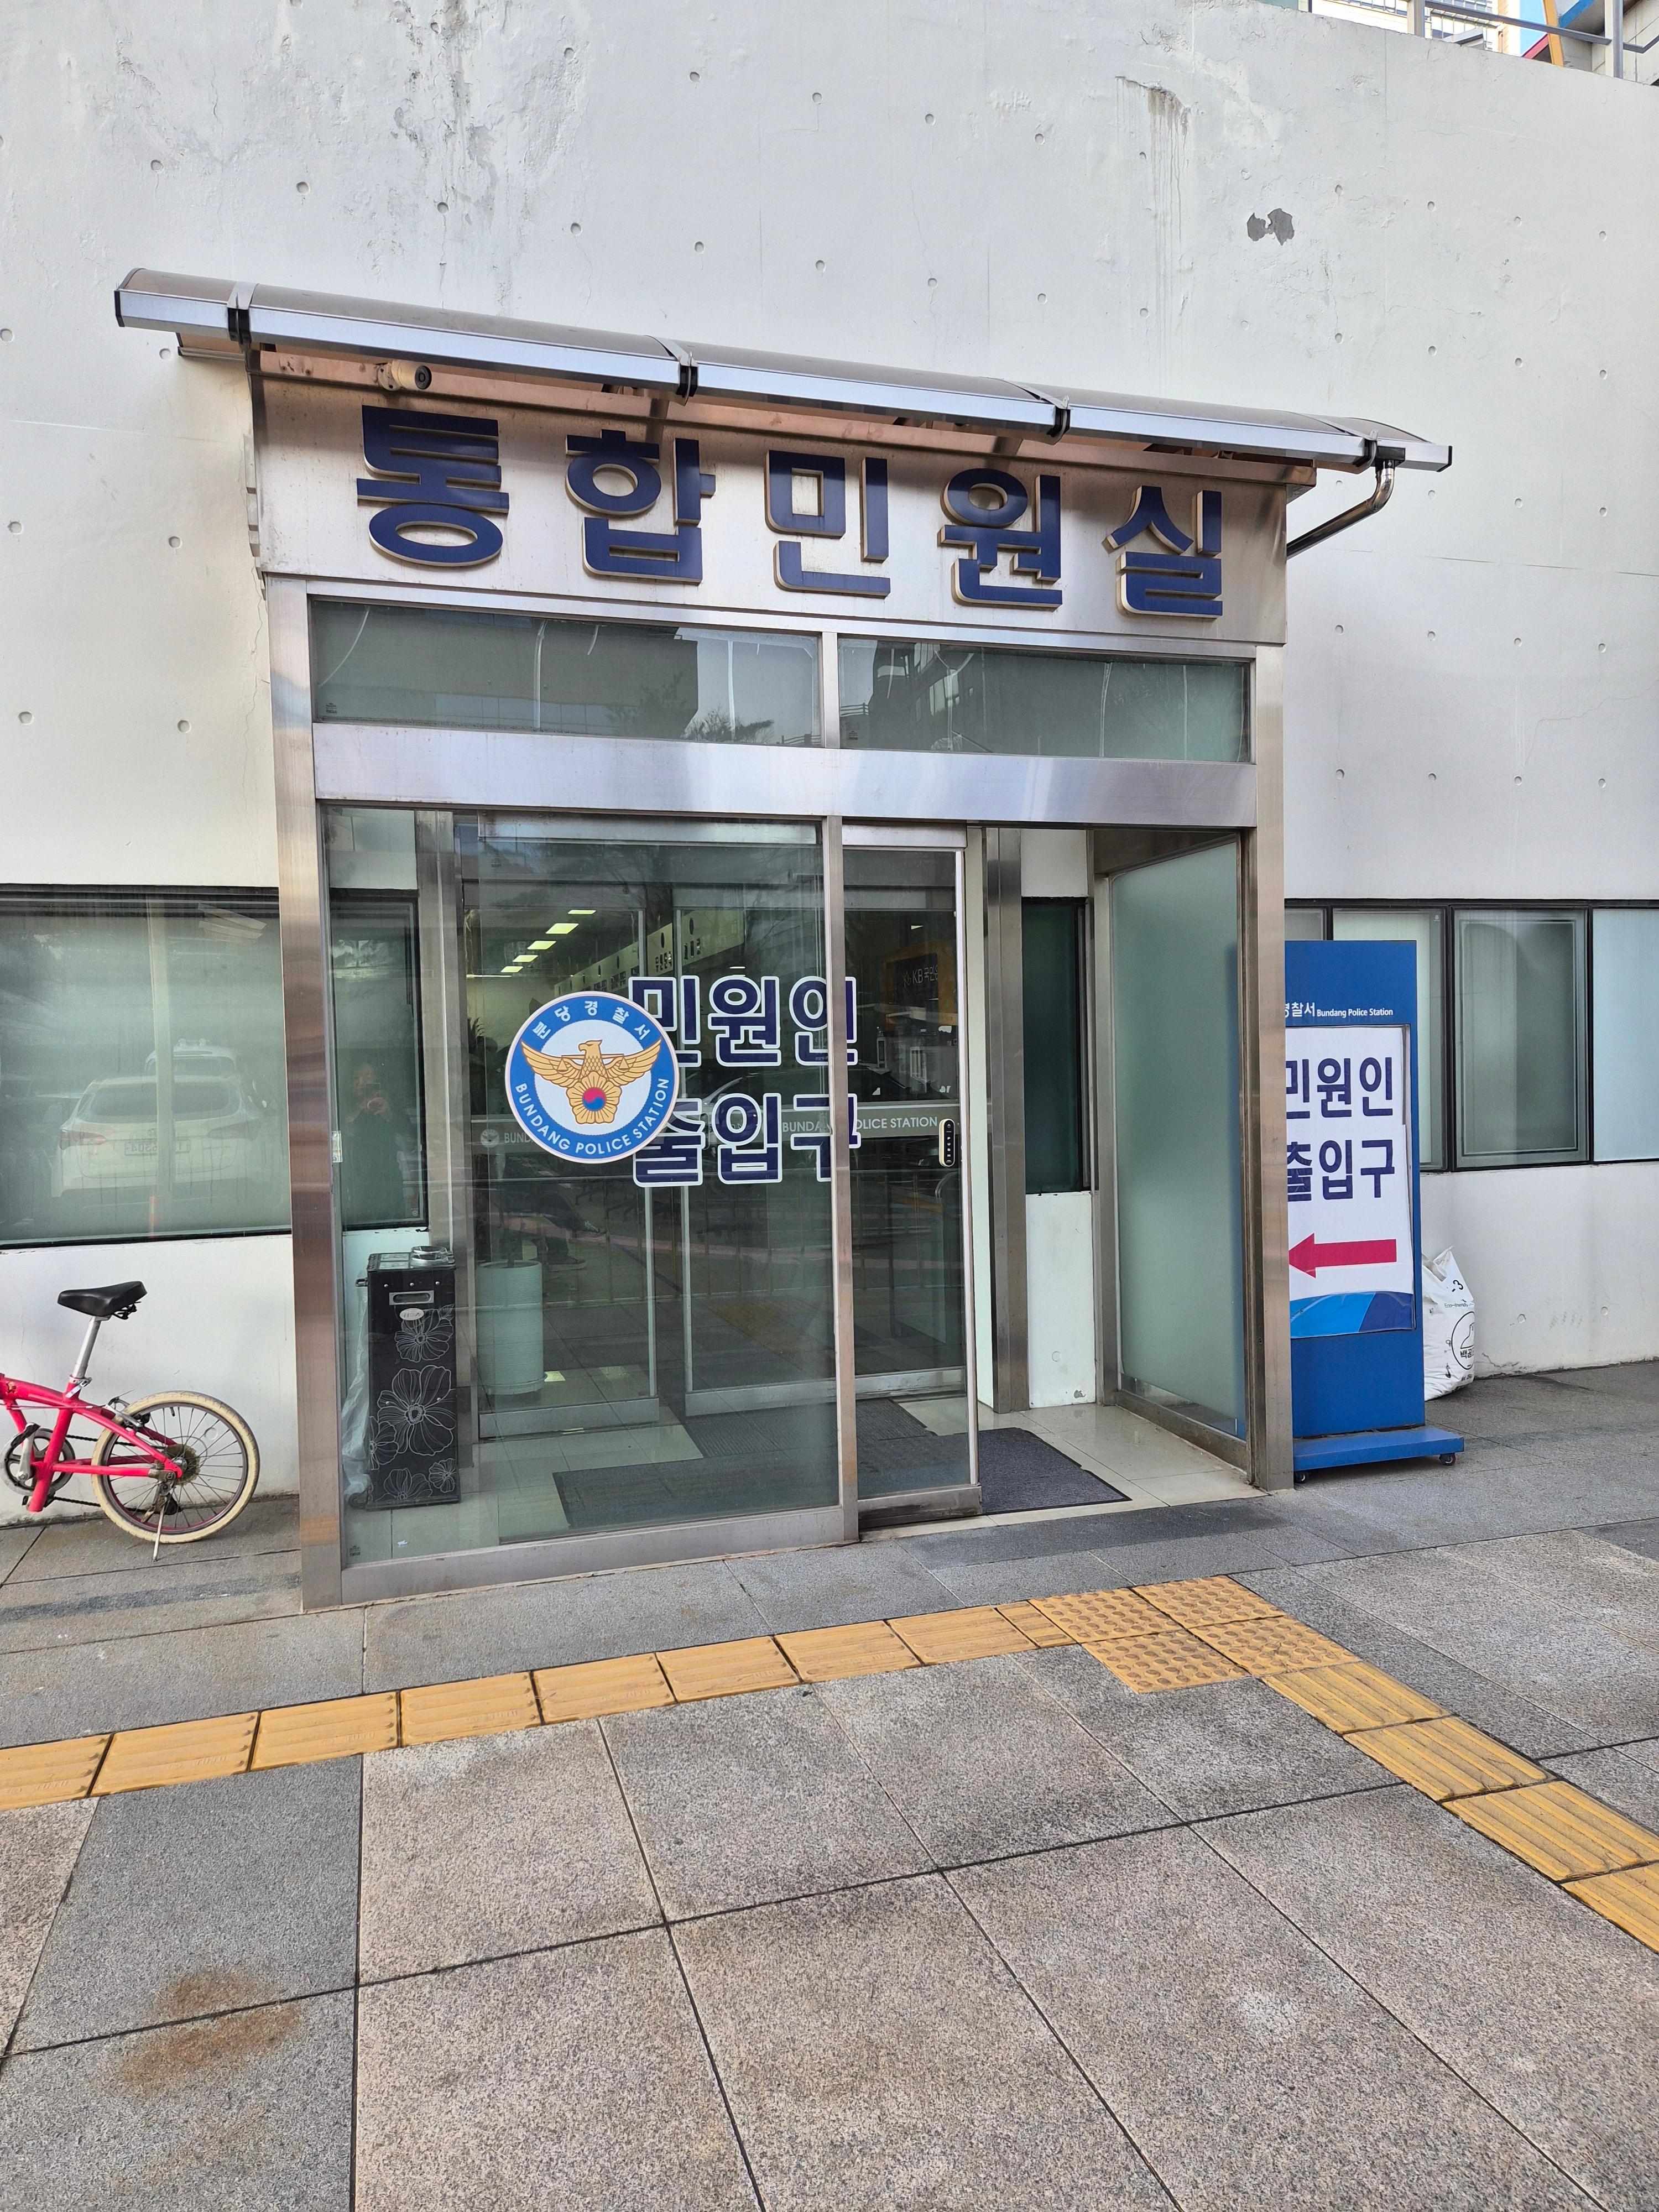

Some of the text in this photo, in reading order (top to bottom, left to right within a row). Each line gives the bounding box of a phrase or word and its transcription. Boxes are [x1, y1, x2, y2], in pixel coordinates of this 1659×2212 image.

[356, 404, 1223, 619] 통합민원실
[533, 1000, 651, 1040] 분당경찰서
[629, 975, 858, 1067] 민원인
[1317, 1007, 1394, 1018] Bundang Police Station
[515, 1078, 670, 1155] BUNDANG POLICE STATION
[1286, 1057, 1393, 1119] 민원인
[857, 1118, 887, 1130] OLICE
[891, 1117, 937, 1128] STATION
[1287, 1139, 1395, 1202] 출입구
[1460, 1348, 1474, 1359] 백곰
